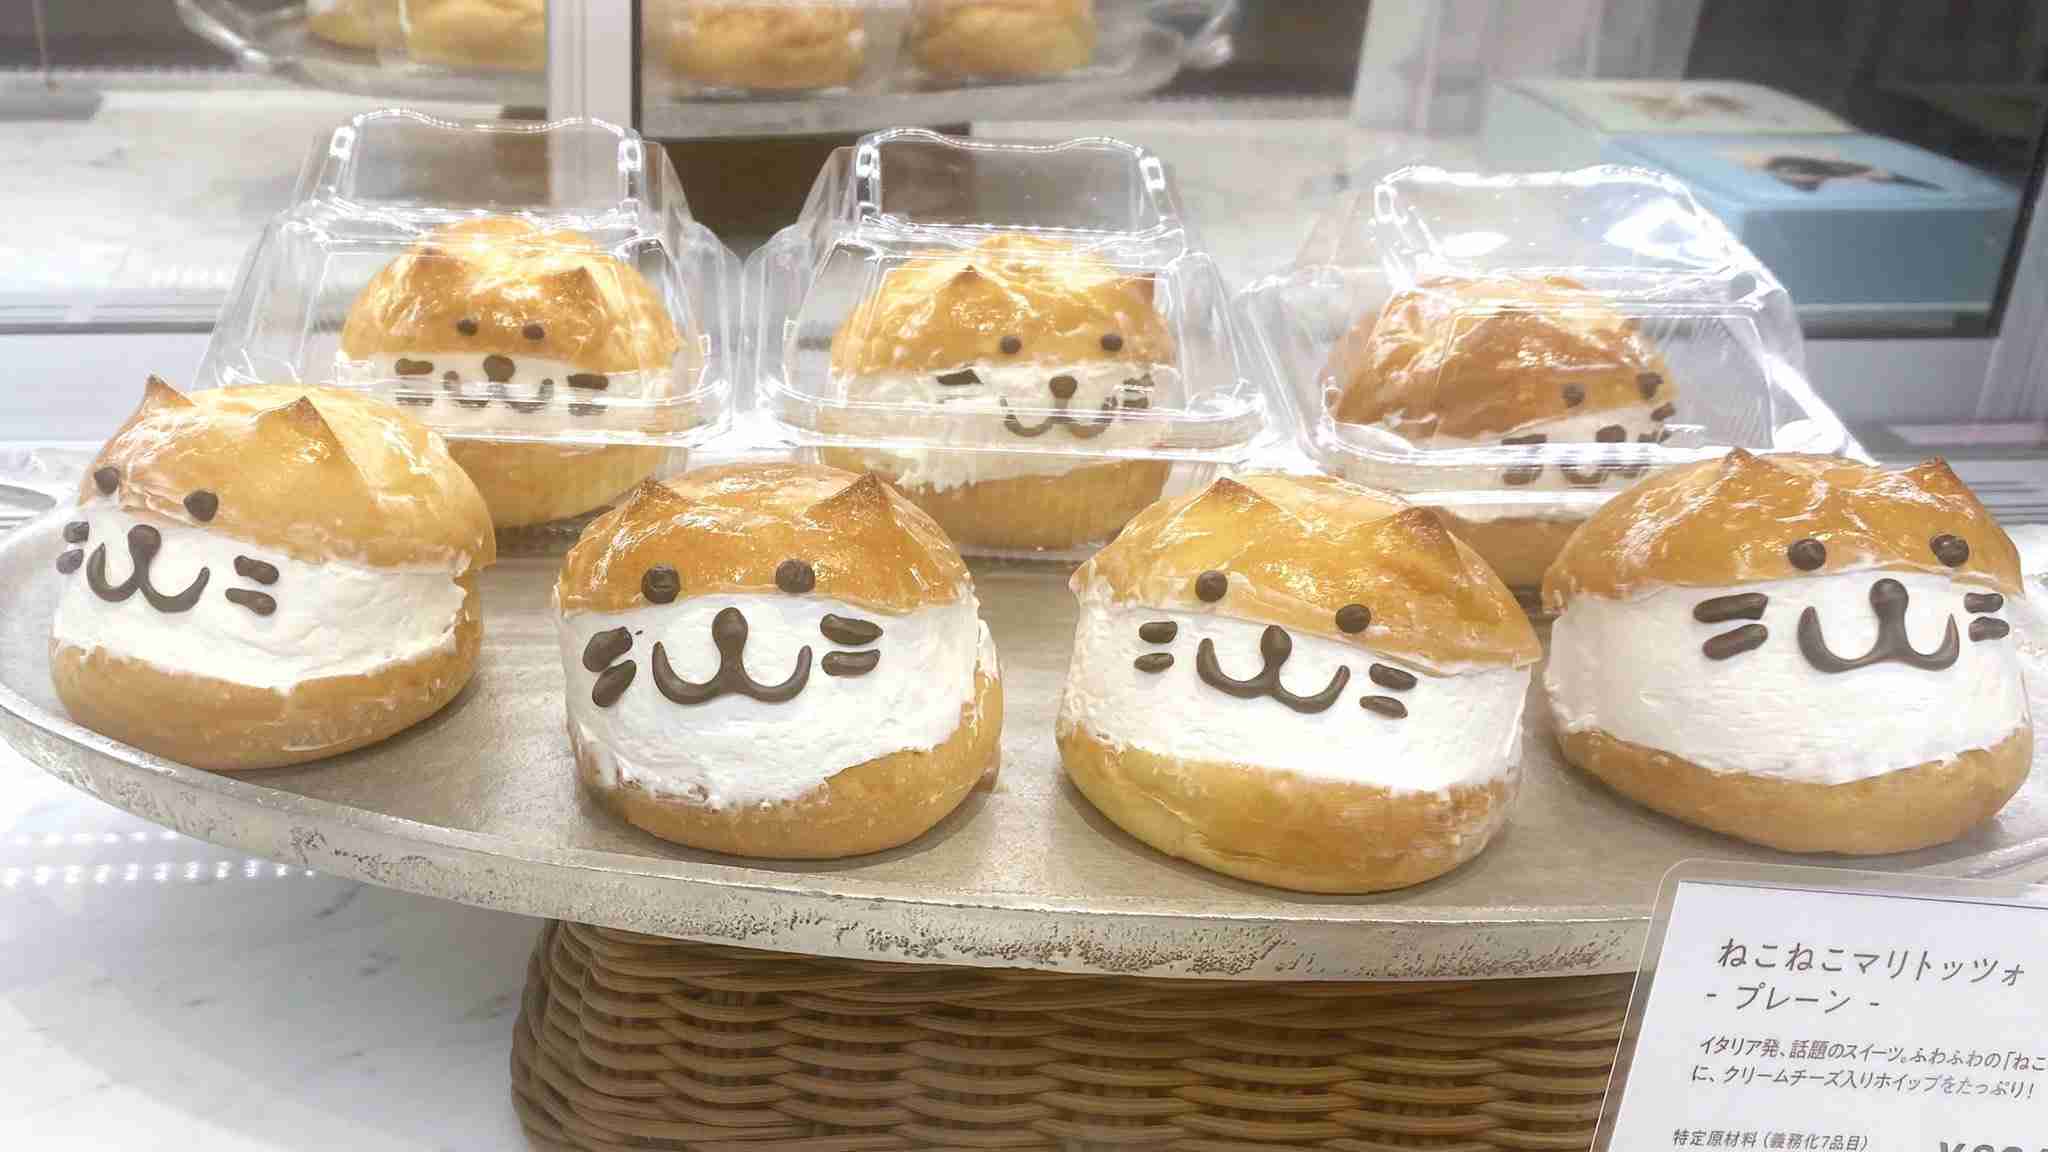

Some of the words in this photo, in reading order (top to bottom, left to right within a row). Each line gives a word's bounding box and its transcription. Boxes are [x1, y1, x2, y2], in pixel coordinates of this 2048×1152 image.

[1717, 938, 2025, 986] ねこねこマリトッツォ
[1736, 981, 1851, 1013] プレーン
